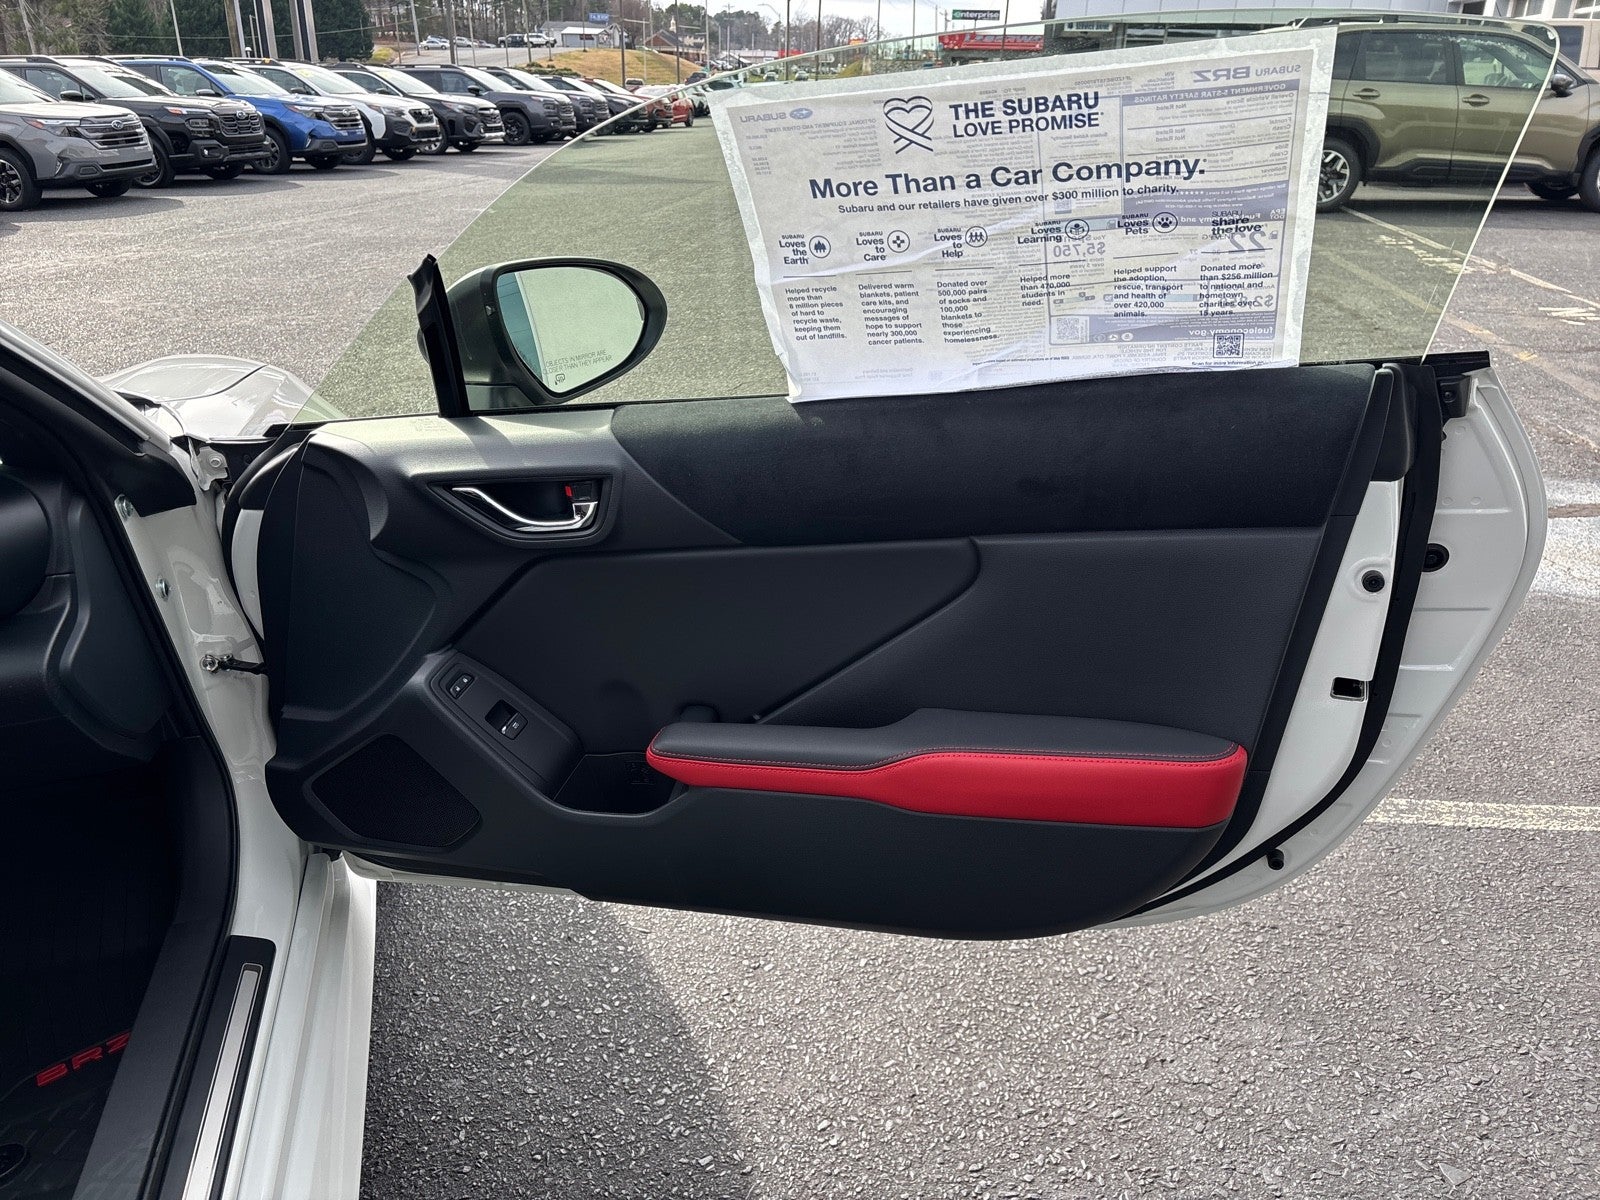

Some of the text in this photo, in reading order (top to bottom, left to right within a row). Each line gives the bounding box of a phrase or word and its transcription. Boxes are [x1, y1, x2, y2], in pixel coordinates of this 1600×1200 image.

[953, 10, 998, 19] enterprise
[949, 91, 1099, 120] THE SUBARU
[953, 112, 1100, 138] LOVE PROMISE
[810, 159, 1205, 199] More Than a Car Company.
[838, 204, 874, 214] Subaru
[877, 204, 896, 212] and
[898, 203, 916, 211] our
[918, 199, 960, 210] retailers
[964, 197, 991, 207] have
[992, 196, 1022, 207] given
[1024, 193, 1048, 202] over
[1052, 190, 1078, 201] $300
[1081, 188, 1119, 198] million
[1122, 187, 1135, 196] to
[1137, 184, 1179, 197] charity.
[1118, 219, 1149, 228] Loves
[1212, 217, 1249, 226] share
[1031, 226, 1062, 234] Loves
[1125, 227, 1149, 235] Pets
[1212, 224, 1262, 236] the love
[856, 237, 884, 246] Loves
[934, 234, 962, 242] Loves
[1018, 234, 1062, 244] Learning
[779, 240, 806, 248] Loves
[952, 241, 962, 249] to
[792, 248, 807, 256] the
[874, 245, 885, 253] to
[864, 254, 886, 262] Care
[942, 250, 963, 259] Help
[784, 256, 808, 265] Earth
[1114, 266, 1142, 275] Helped
[1144, 265, 1177, 273] support
[1200, 264, 1236, 272] Donated
[1020, 275, 1048, 284] Helped
[1129, 274, 1167, 283] adoption,
[1040, 281, 1070, 290] 470,000
[1145, 283, 1183, 292] transport
[1210, 282, 1244, 290] national
[785, 287, 810, 295] Helped
[860, 290, 919, 299] blankets, patient
[938, 288, 987, 297] 500,000 pairs
[1022, 290, 1055, 299] students
[1134, 301, 1164, 309] 420,000
[862, 307, 908, 315] encouraging
[894, 322, 922, 330] support
[818, 332, 847, 340] landfills.
[867, 331, 888, 339] nearly
[943, 327, 991, 336] experiencing
[944, 334, 1000, 343] homelessness.
